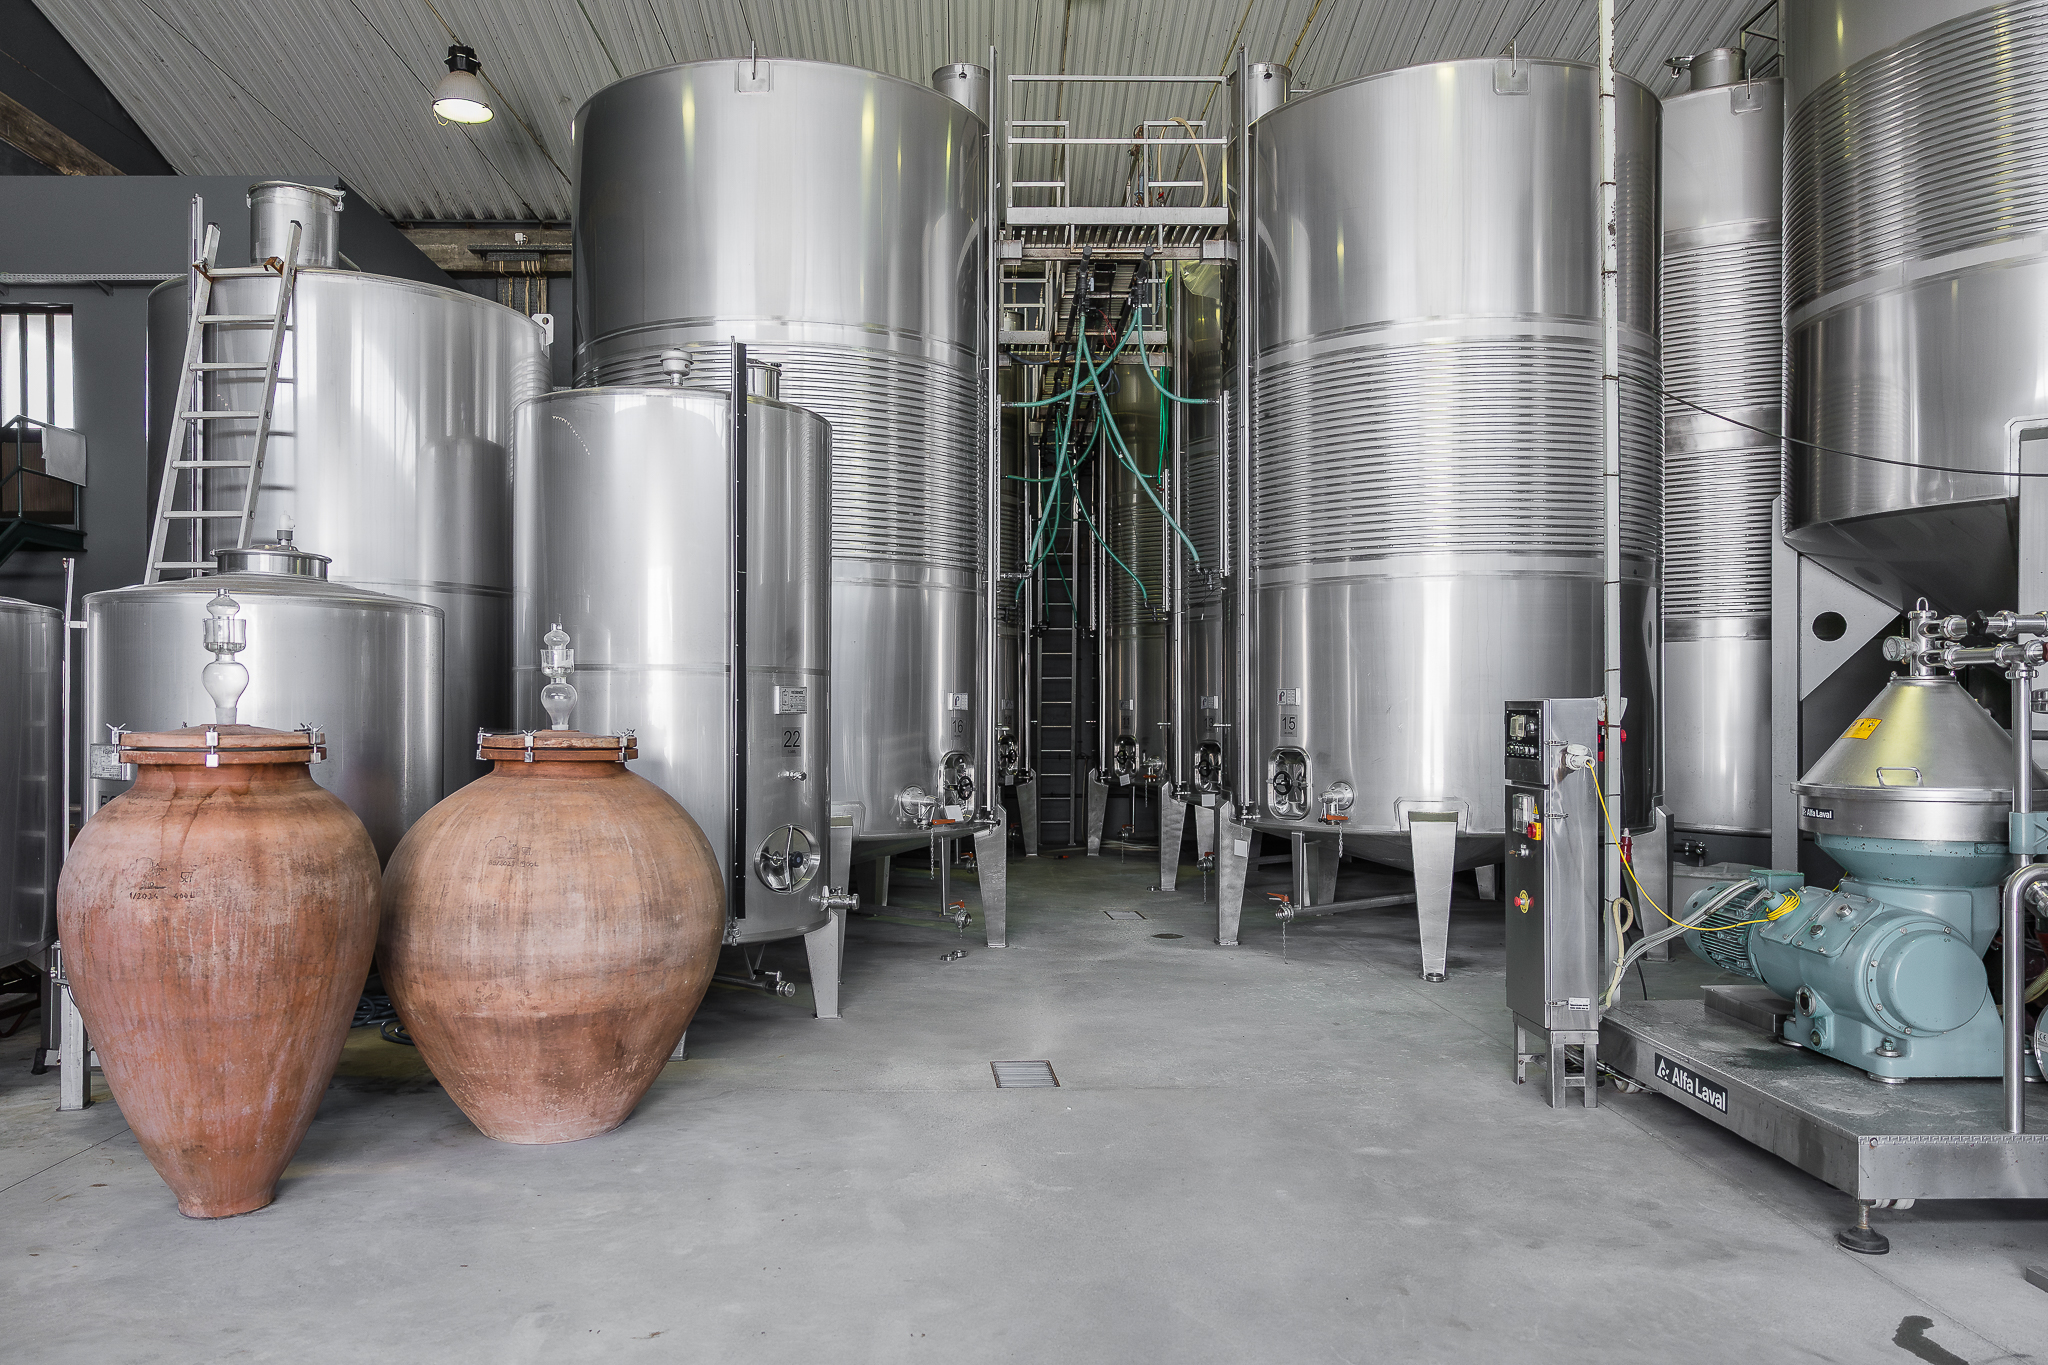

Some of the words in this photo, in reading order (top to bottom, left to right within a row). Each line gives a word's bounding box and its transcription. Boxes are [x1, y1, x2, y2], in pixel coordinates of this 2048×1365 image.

[952, 719, 964, 734] 16
[1203, 717, 1214, 728] 13
[1281, 716, 1296, 731] 15
[783, 730, 801, 748] 22
[1806, 808, 1816, 818] Alfa
[1815, 809, 1832, 819] Laval
[1671, 1066, 1694, 1094] Alfa
[1694, 1077, 1726, 1112] Laval
